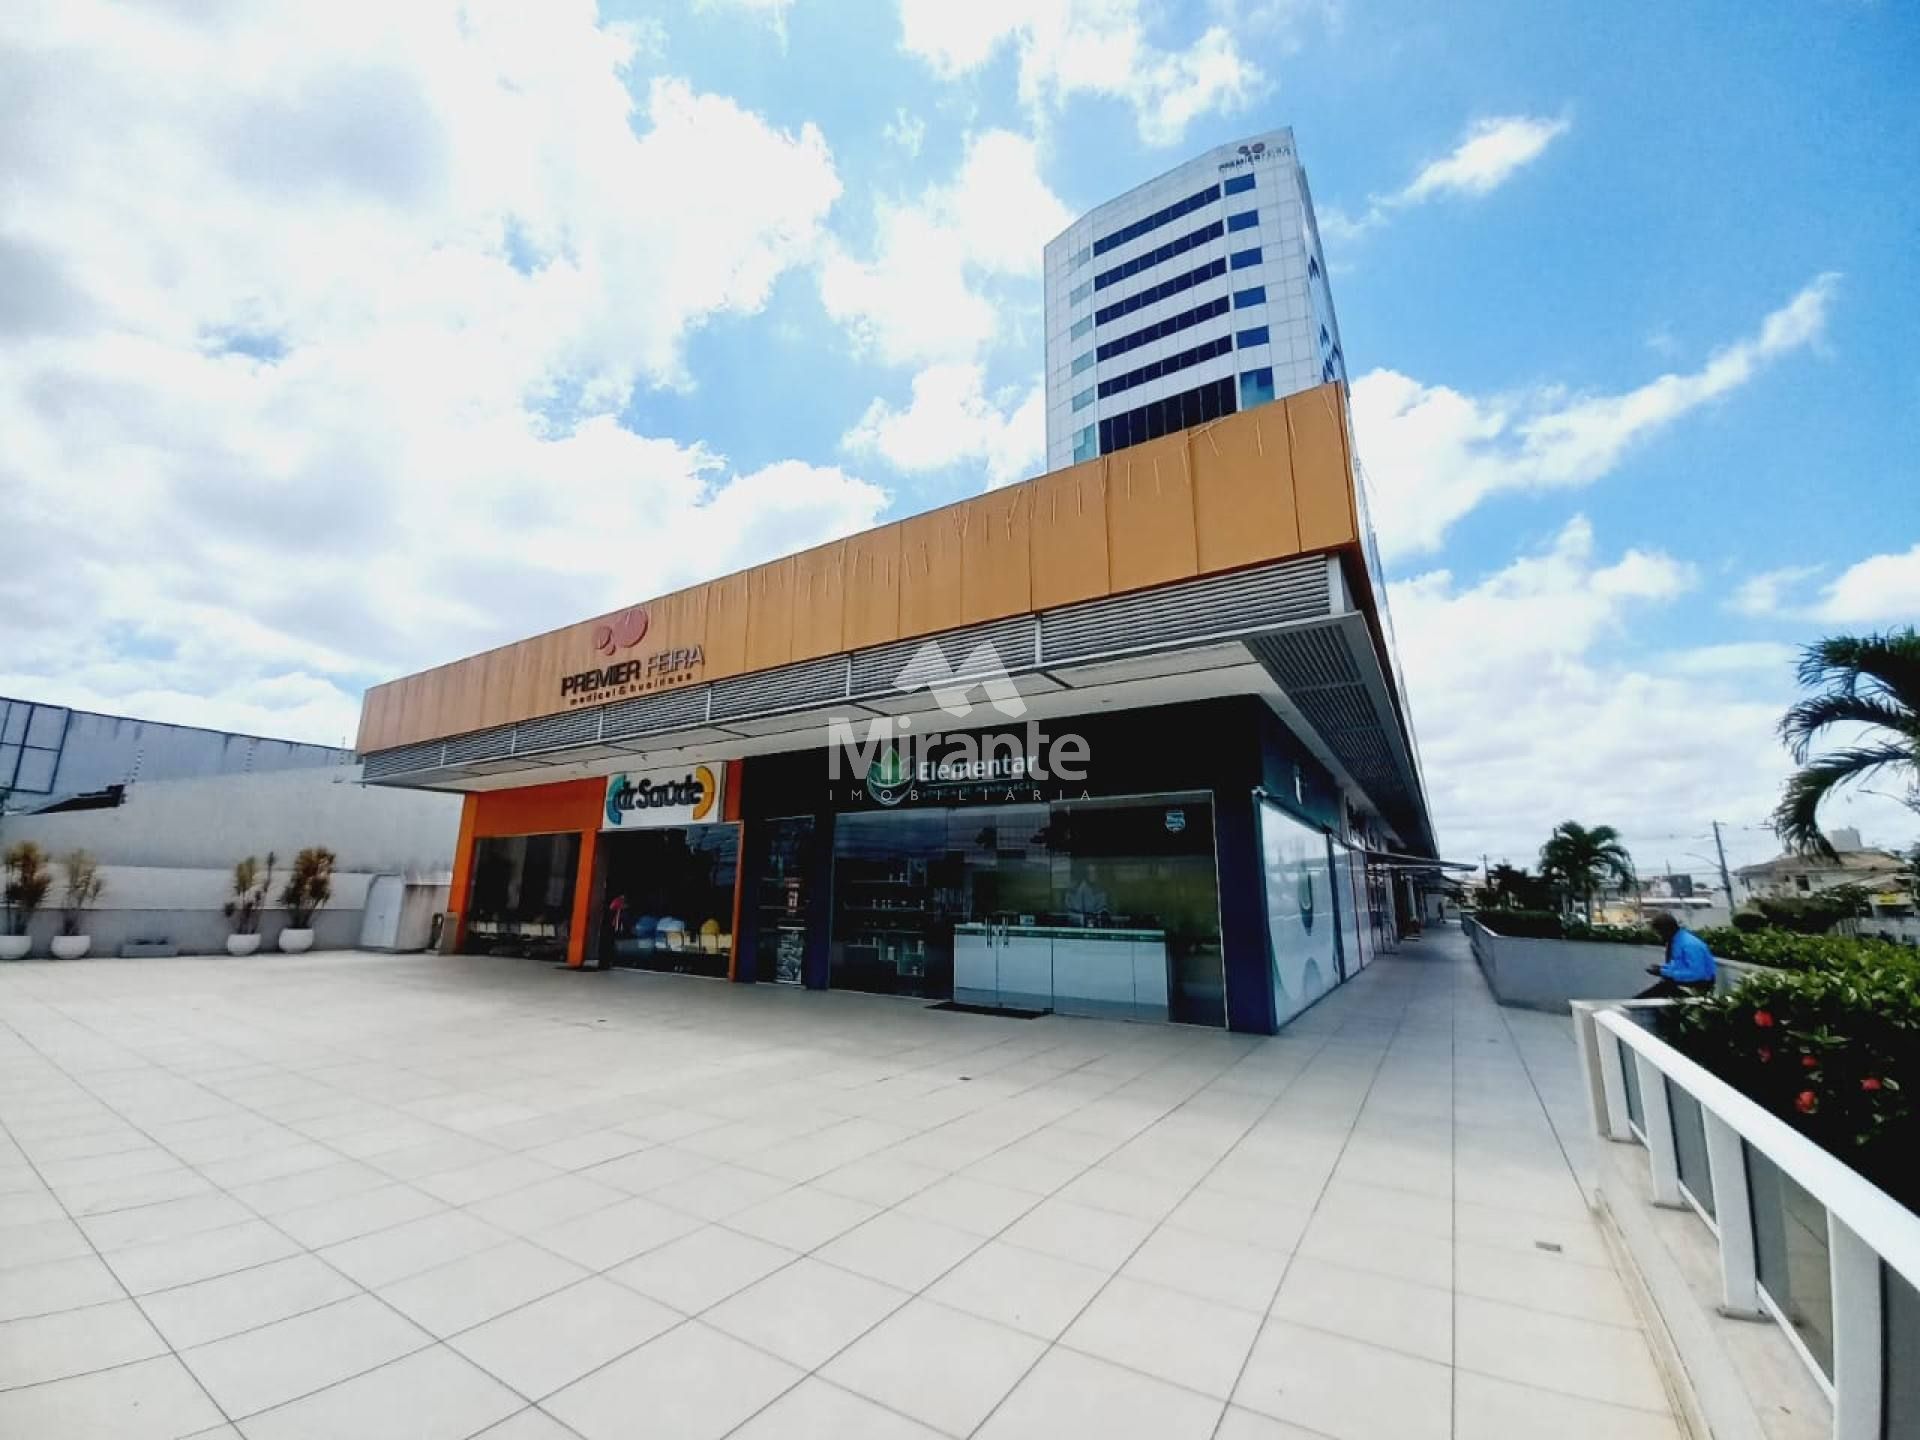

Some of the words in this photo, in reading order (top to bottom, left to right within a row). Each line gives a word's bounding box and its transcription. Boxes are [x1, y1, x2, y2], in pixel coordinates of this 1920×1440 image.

[561, 659, 640, 697] PREMIER
[648, 645, 706, 677] FEIRA
[919, 754, 1038, 781] Elementar
